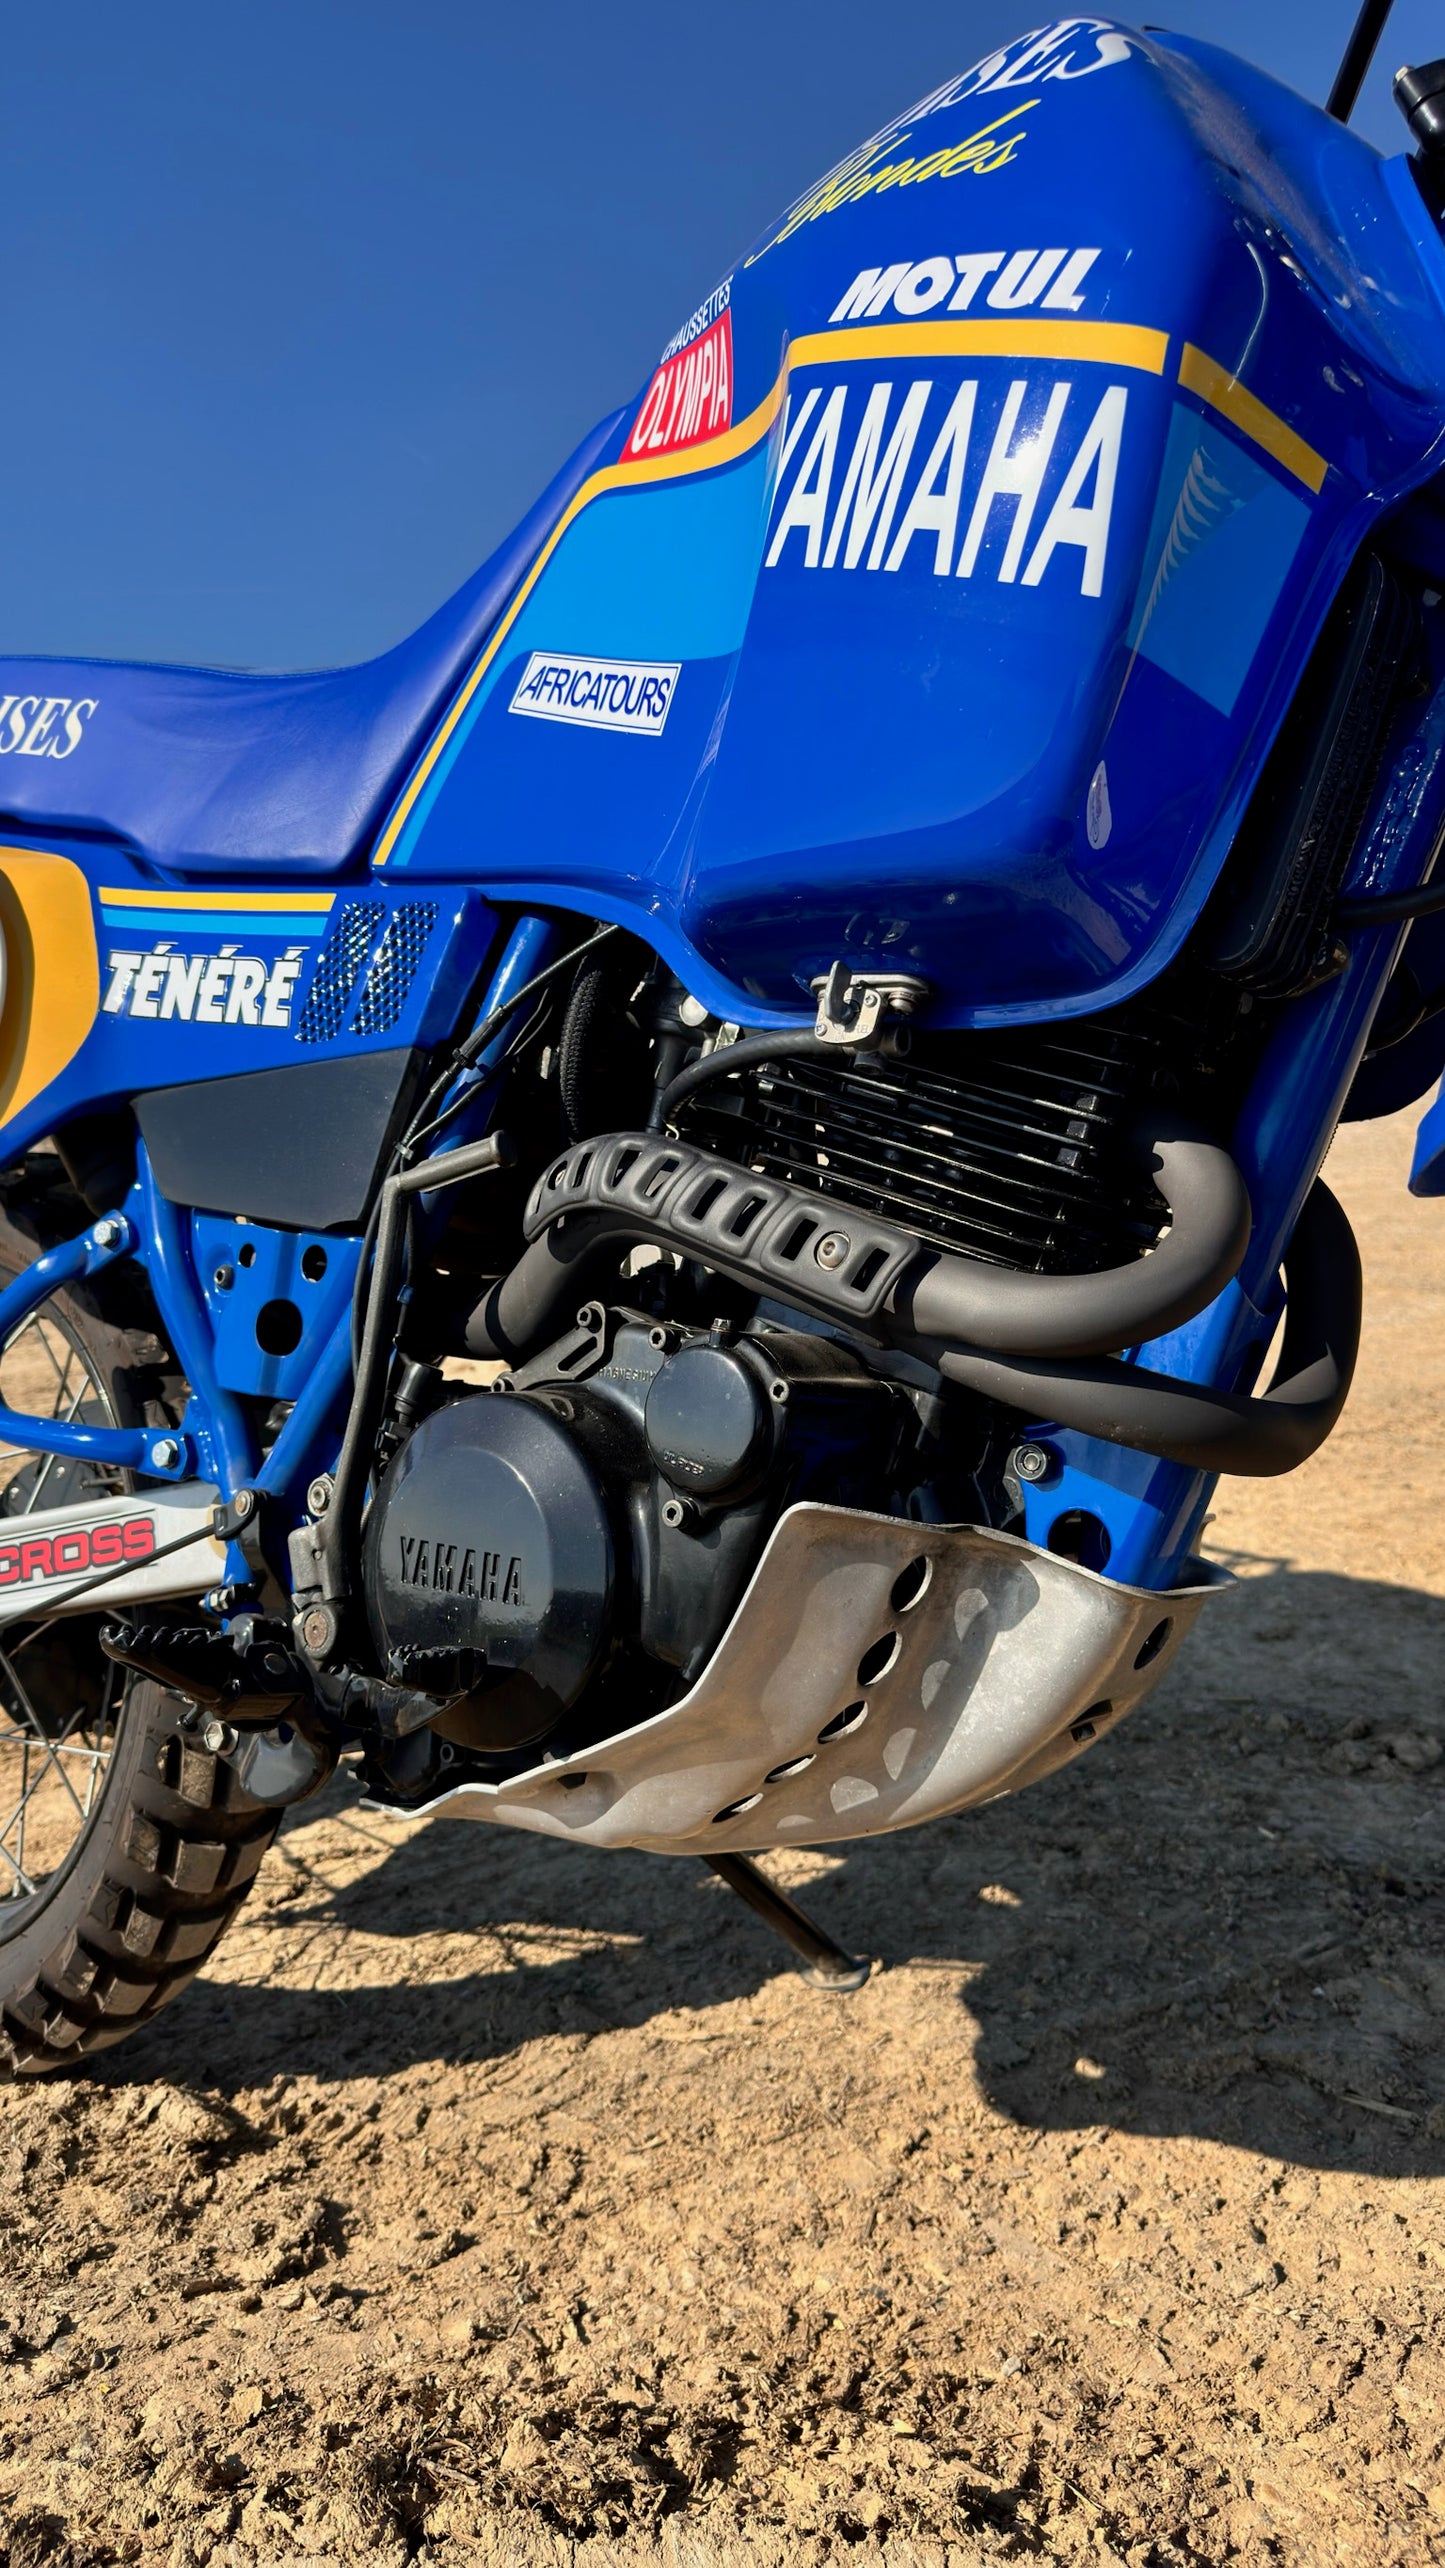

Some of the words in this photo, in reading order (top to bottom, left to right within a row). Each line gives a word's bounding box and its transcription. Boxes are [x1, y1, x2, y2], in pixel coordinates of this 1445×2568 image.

[660, 274, 734, 365] CHAUSSETTES
[828, 248, 1102, 323] MOTUL
[631, 324, 729, 454] OLYMPIA
[765, 380, 1128, 597] YAMAHA
[519, 665, 671, 718] AFRICATOURS
[101, 941, 310, 1028] TÉNÉRÉ
[399, 1535, 523, 1606] YAMAHA
